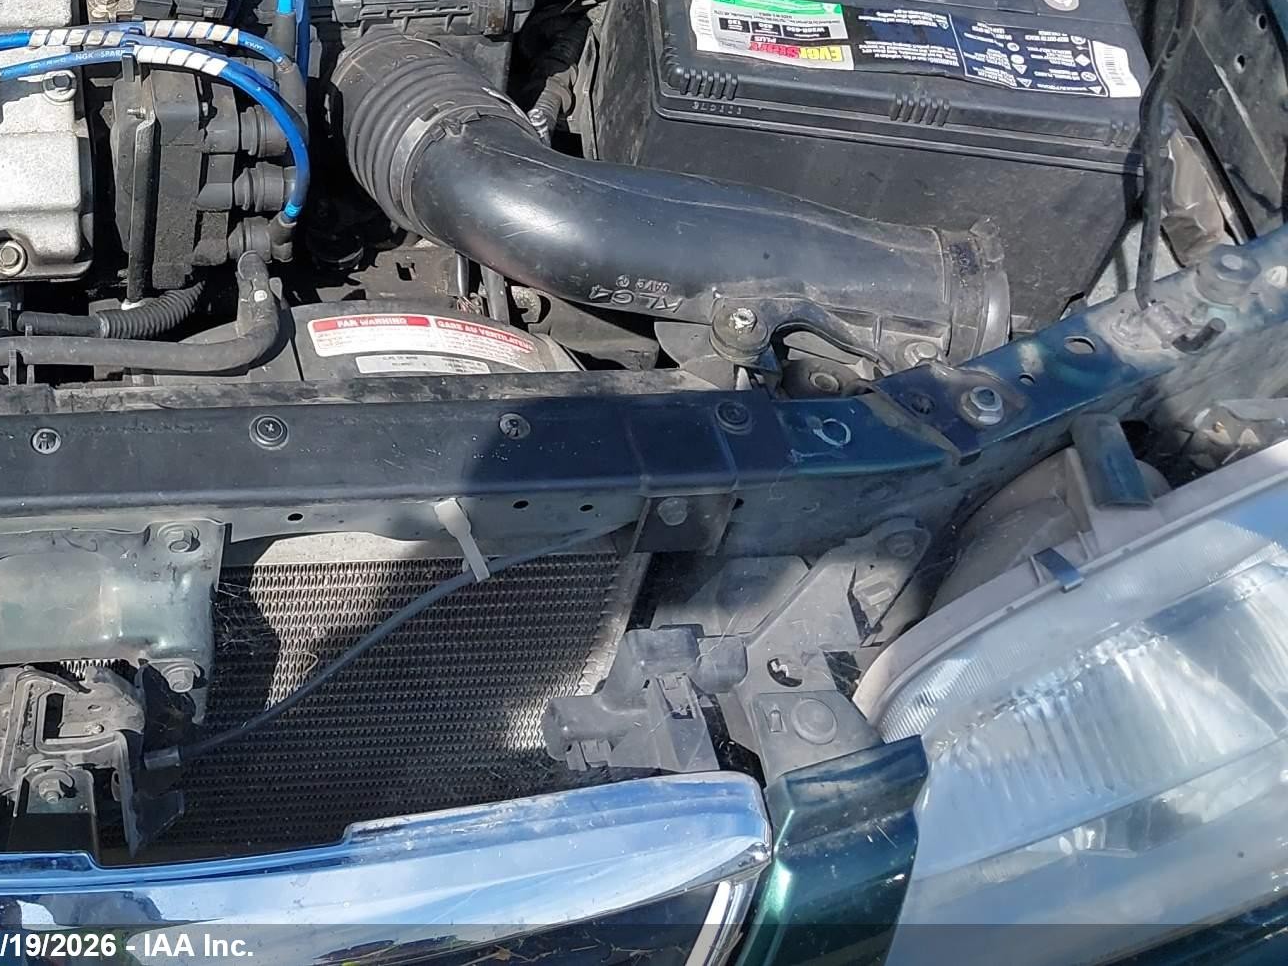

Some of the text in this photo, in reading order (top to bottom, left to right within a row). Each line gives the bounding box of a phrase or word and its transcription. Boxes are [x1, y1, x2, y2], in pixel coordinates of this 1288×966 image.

[753, 35, 777, 44] PLUS
[749, 41, 844, 62] EverStart
[75, 53, 94, 61] NGK
[336, 317, 408, 328] FAN WARNING
